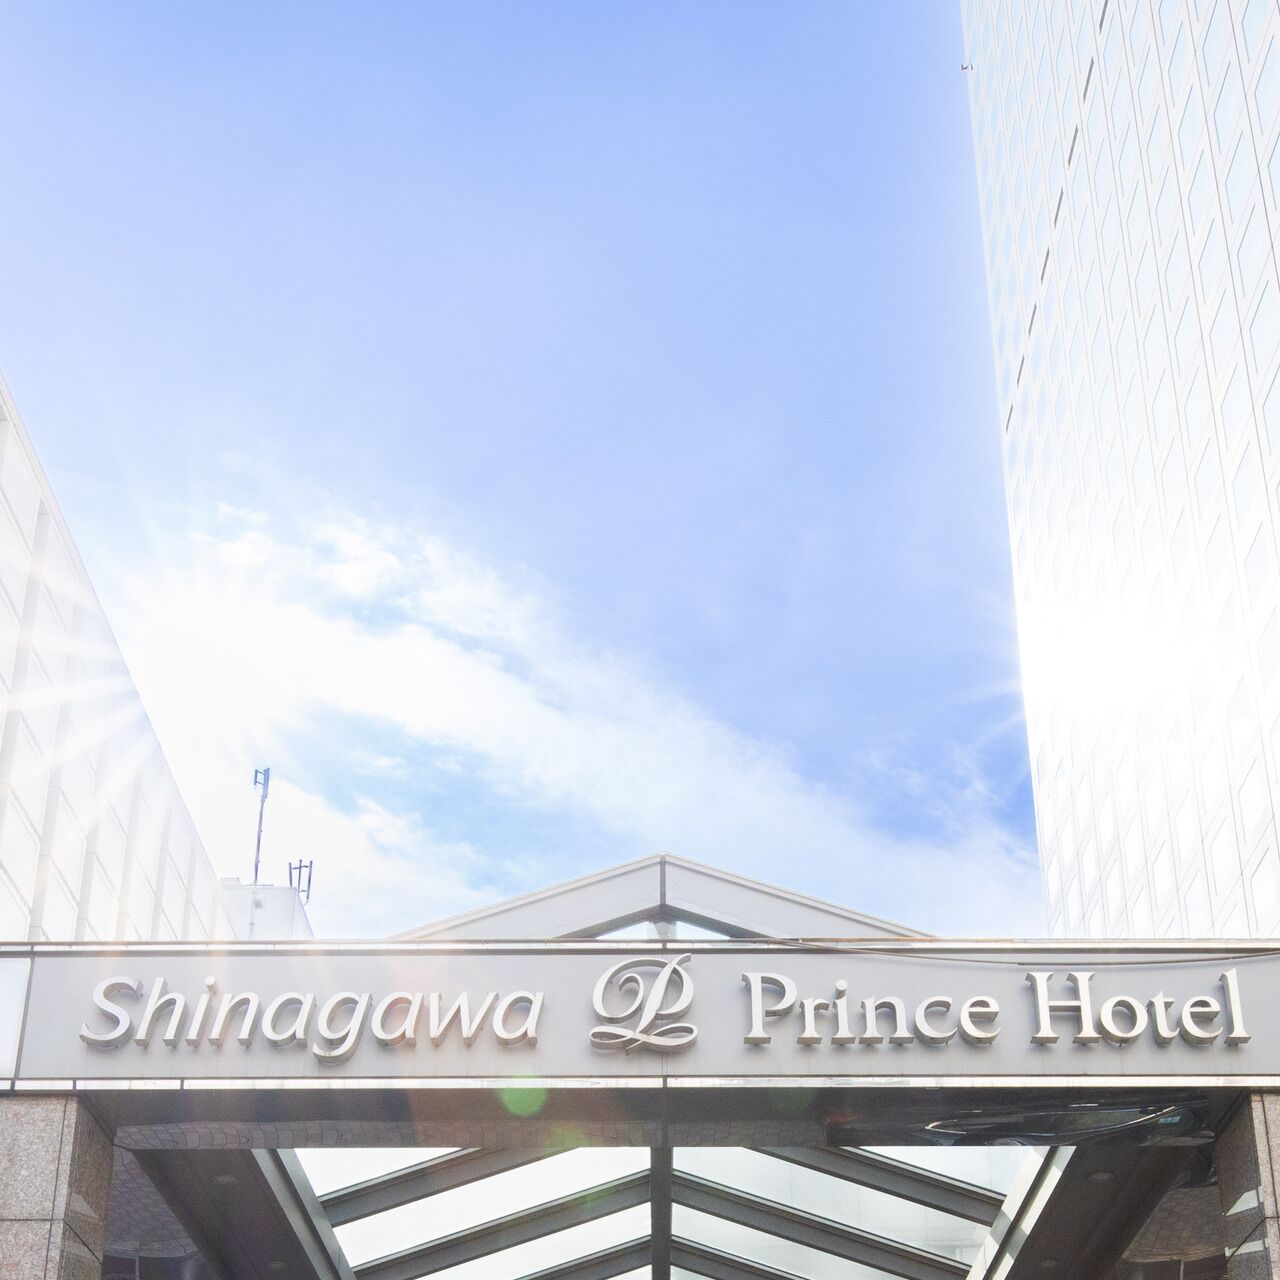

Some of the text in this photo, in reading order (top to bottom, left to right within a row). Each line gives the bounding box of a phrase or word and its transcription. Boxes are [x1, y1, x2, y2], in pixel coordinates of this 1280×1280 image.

[79, 976, 545, 1061] Shinagawa
[742, 971, 1002, 1046] Prince
[1025, 967, 1252, 1047] Hotel
